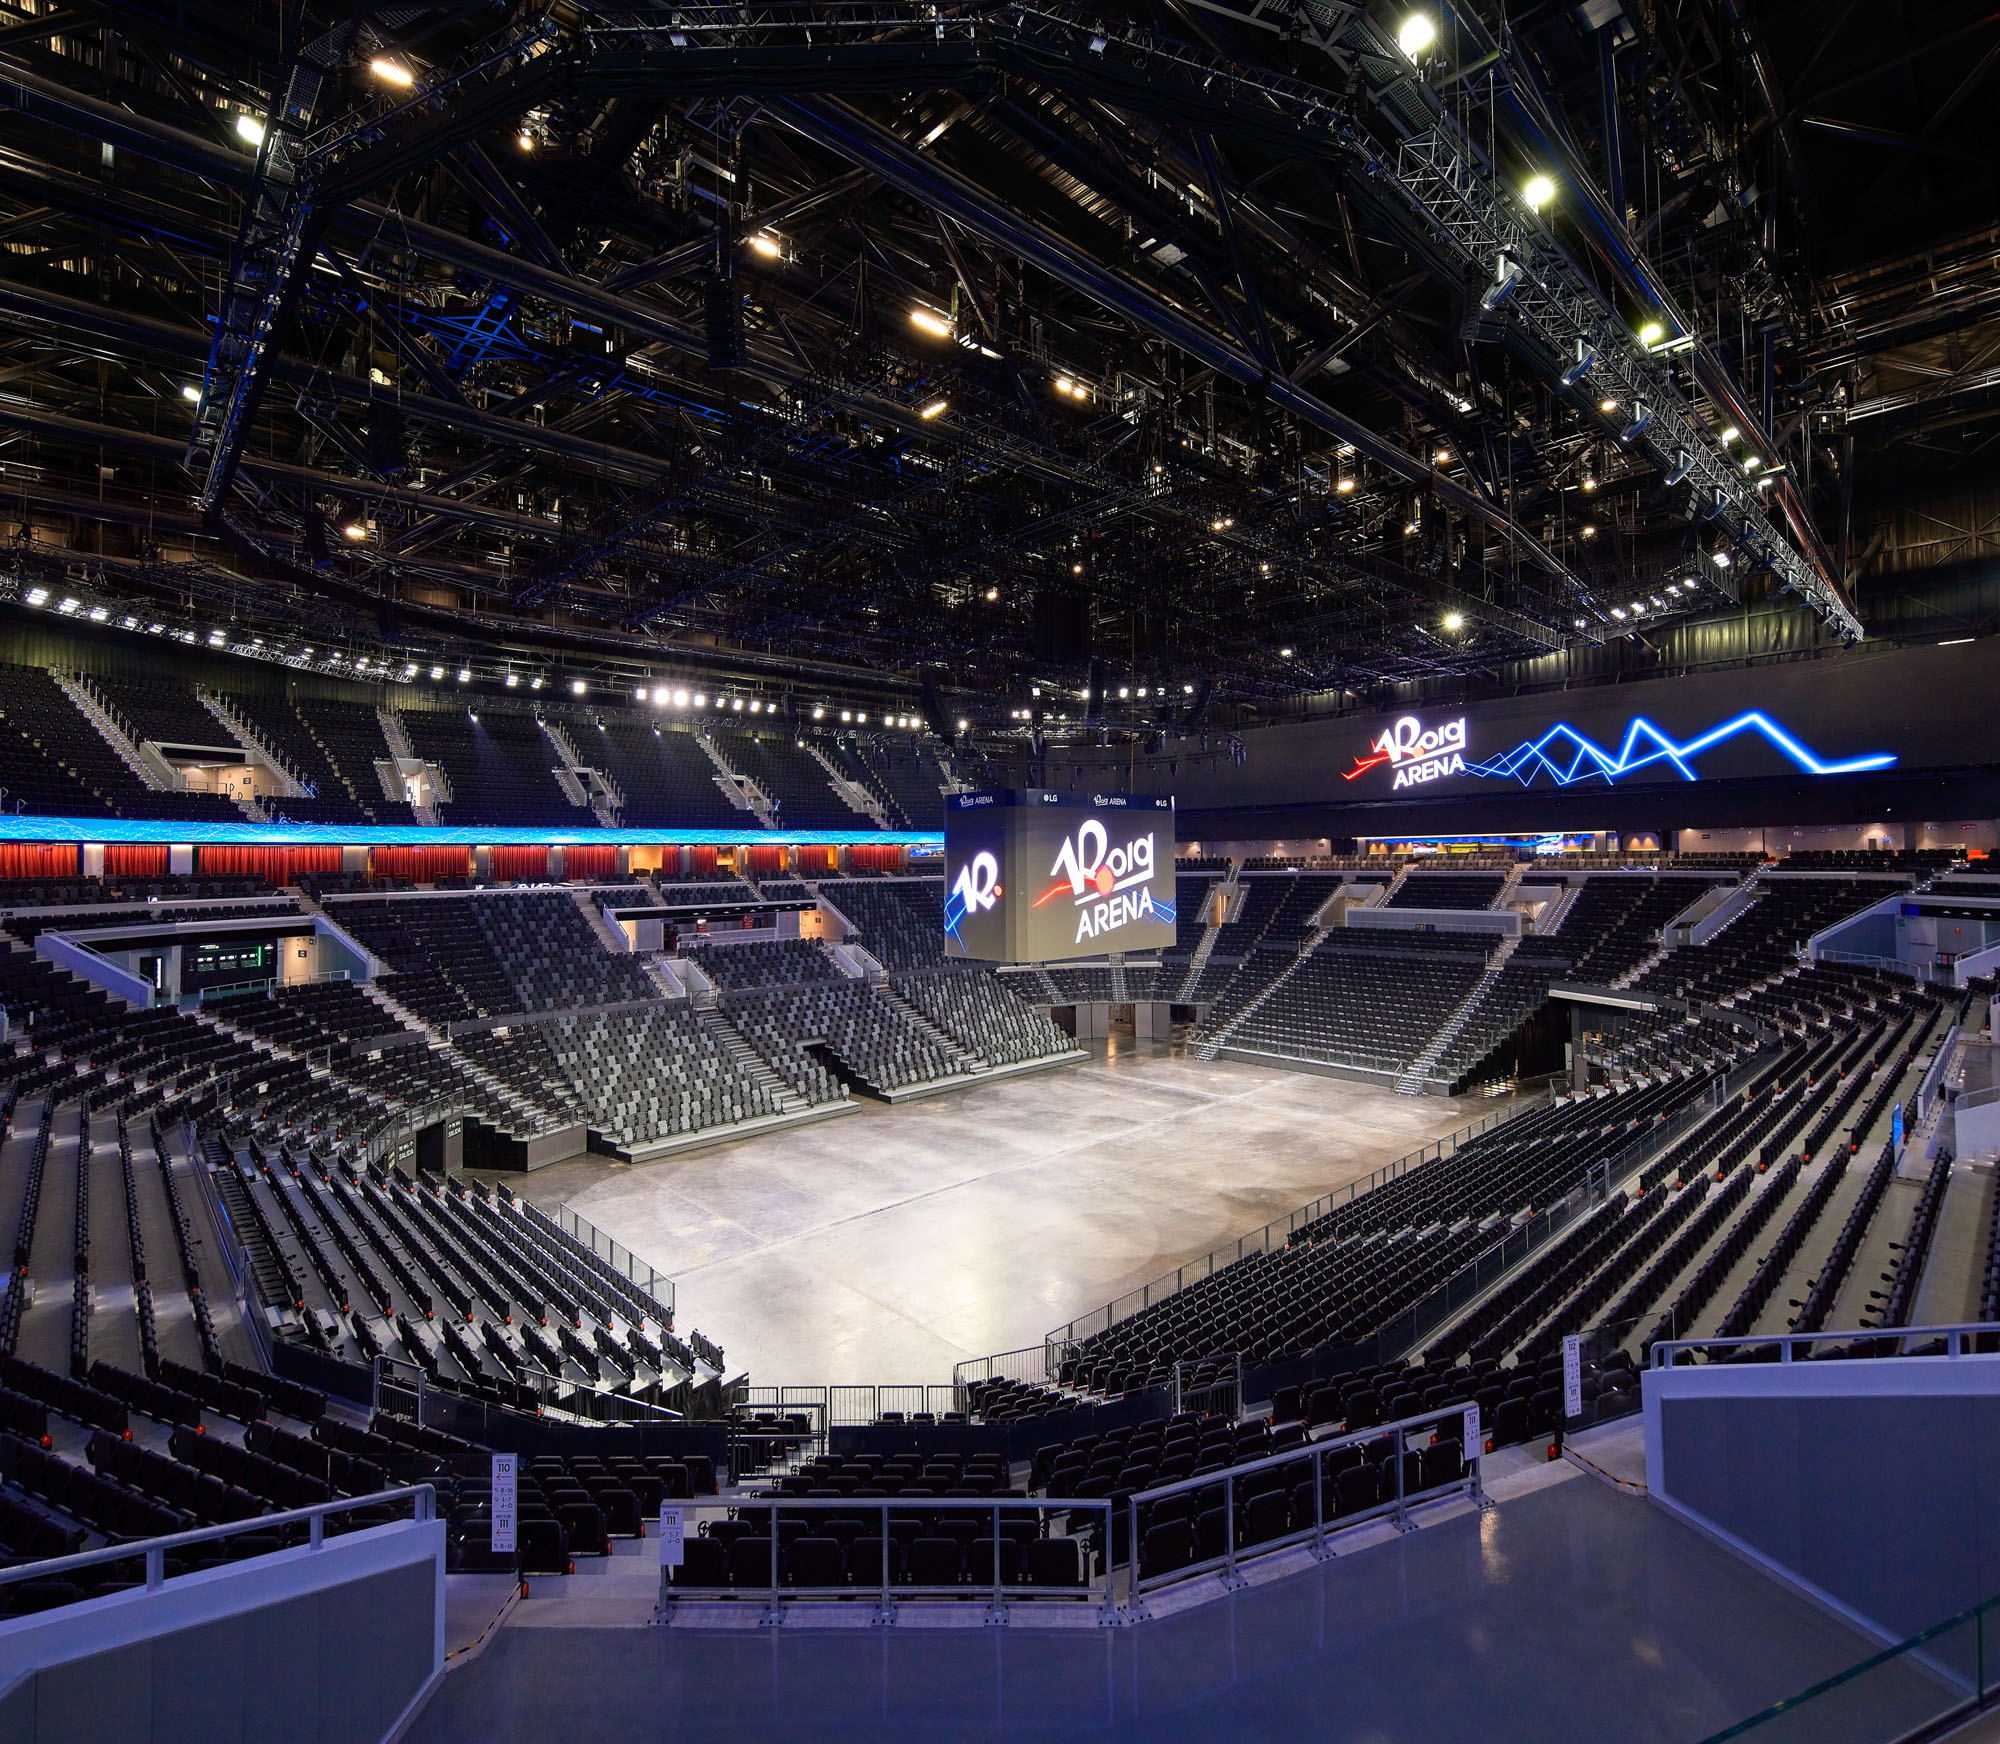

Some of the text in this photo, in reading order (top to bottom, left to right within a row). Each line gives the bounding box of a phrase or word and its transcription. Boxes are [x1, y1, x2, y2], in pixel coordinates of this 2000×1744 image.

[1393, 753, 1466, 790] ARENA
[975, 796, 993, 804] ARENA
[1049, 794, 1058, 802] LG
[1109, 798, 1127, 806] ARENA
[1075, 886, 1154, 943] ARENA
[1568, 1343, 1576, 1351] 112
[498, 1463, 511, 1473] 110
[500, 1519, 509, 1528] 111
[666, 1516, 676, 1525] 111
